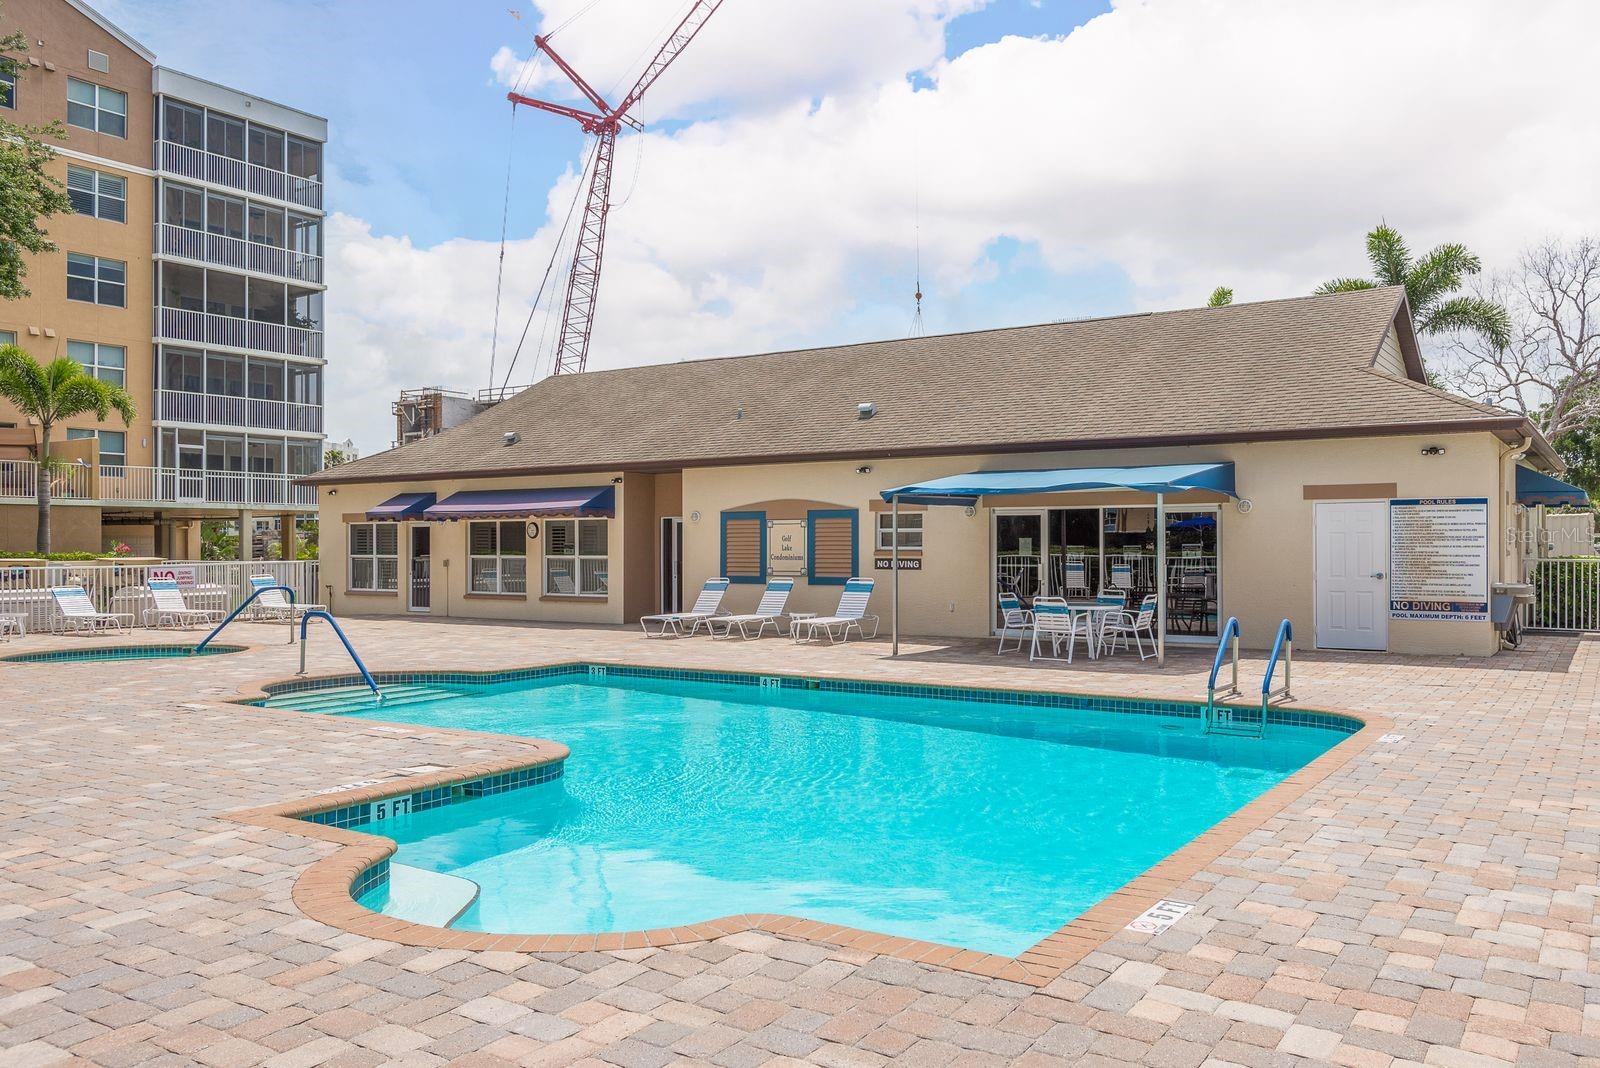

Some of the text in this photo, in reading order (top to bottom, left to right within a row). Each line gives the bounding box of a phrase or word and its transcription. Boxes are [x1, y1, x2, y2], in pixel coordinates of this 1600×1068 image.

[770, 553, 804, 561] Condominiums
[877, 560, 889, 568] NO
[1392, 601, 1410, 610] NO
[1412, 601, 1451, 611] DIVING
[762, 678, 768, 688] 4
[376, 803, 386, 821] 5
[1147, 912, 1173, 920] 5
